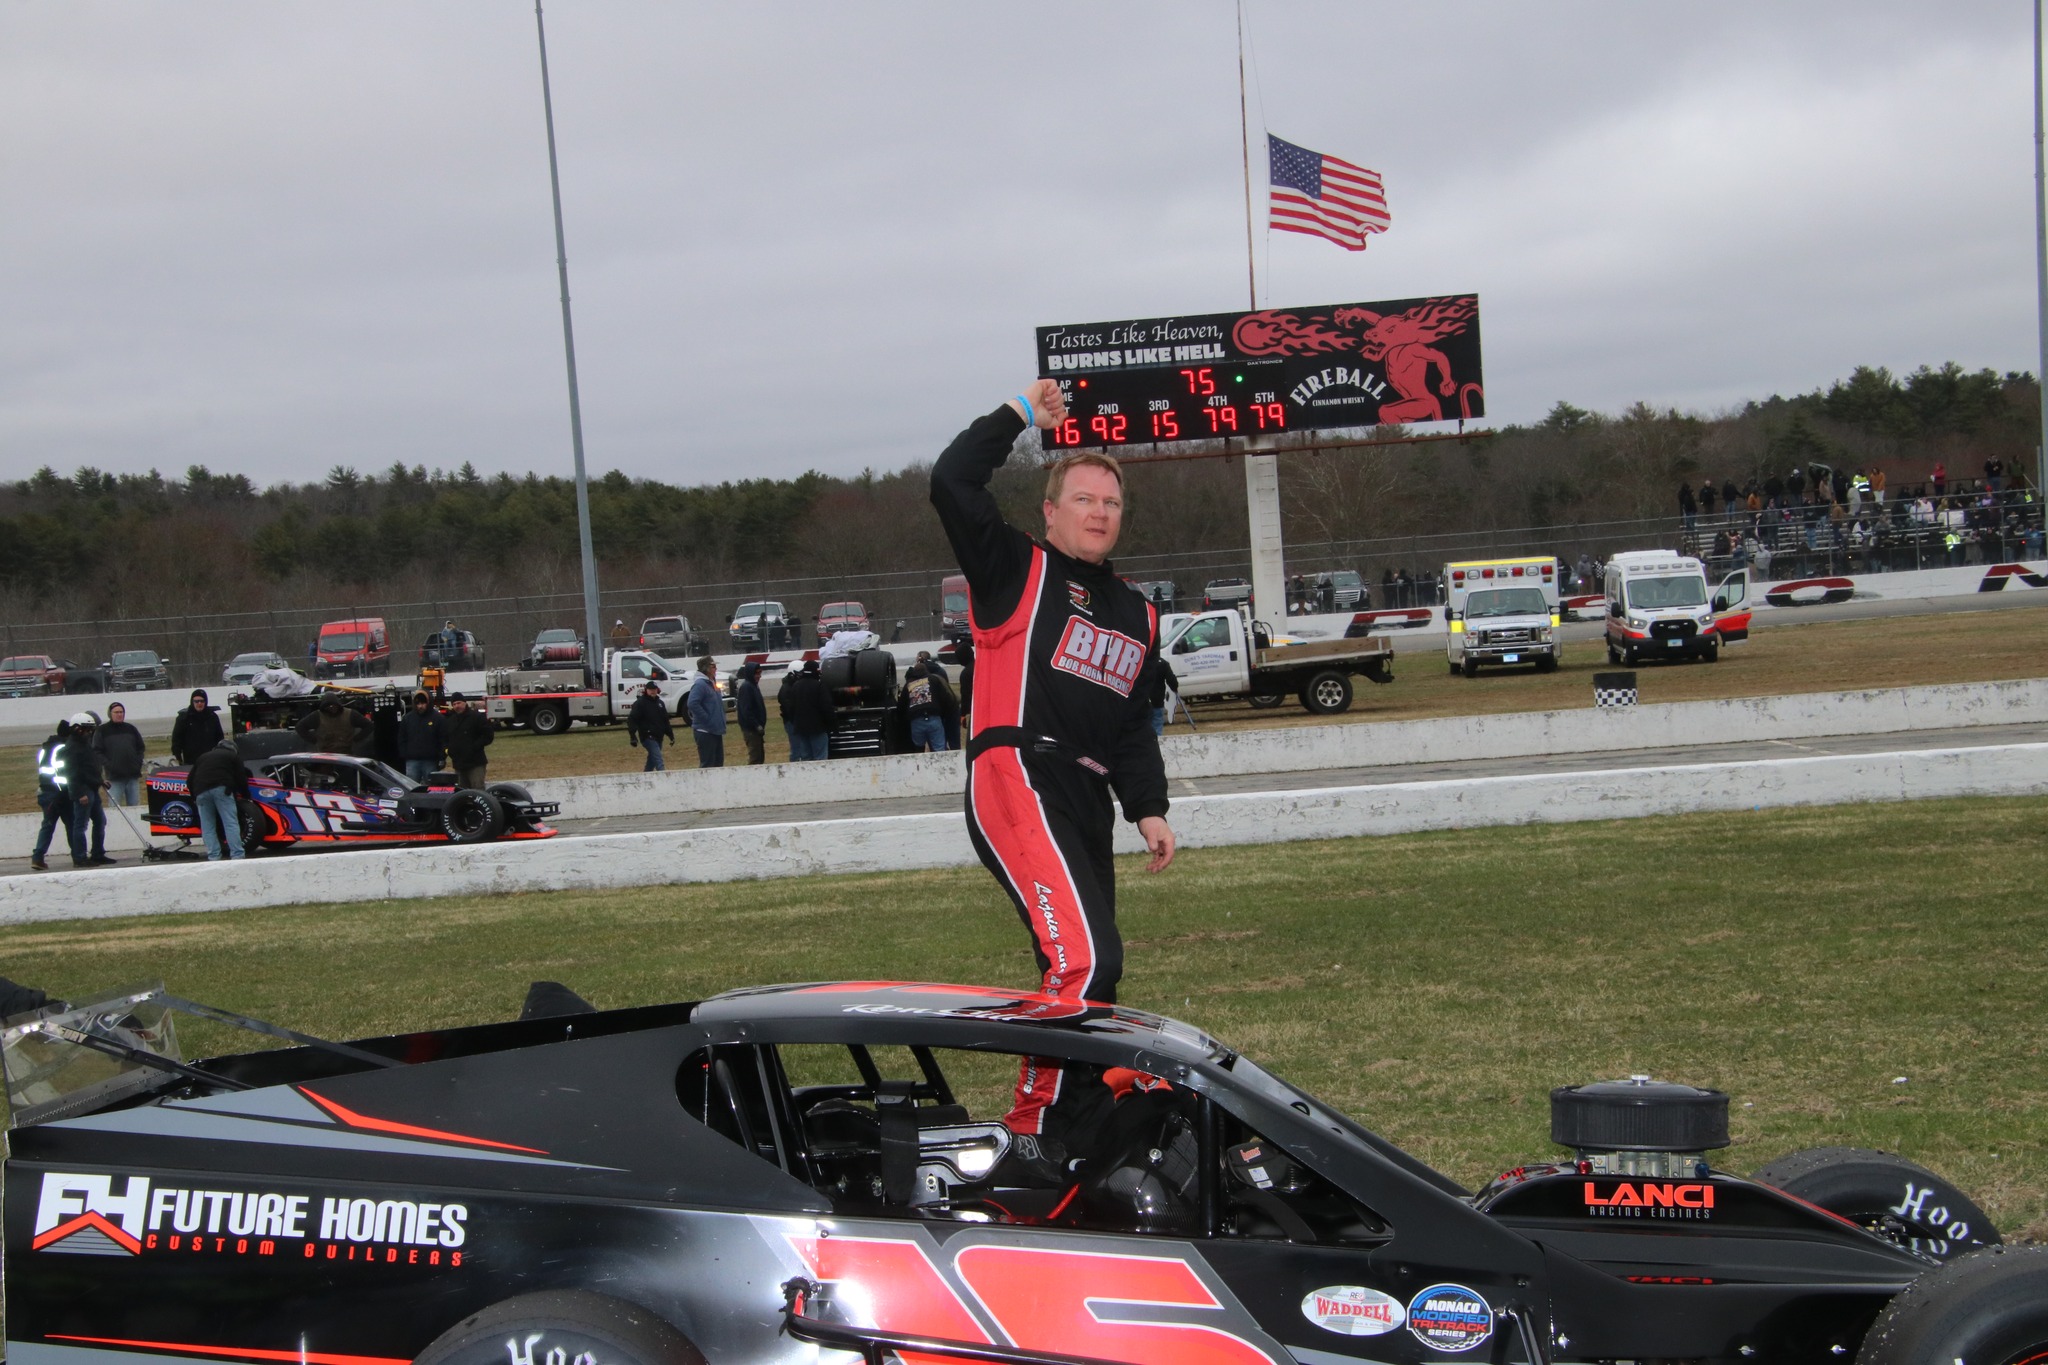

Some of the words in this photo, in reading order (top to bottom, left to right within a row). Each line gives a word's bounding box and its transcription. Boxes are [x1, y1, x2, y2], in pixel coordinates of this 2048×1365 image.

[1046, 328, 1102, 349] Tastes
[1108, 322, 1146, 346] Like
[1152, 319, 1223, 342] Heaven,
[1048, 350, 1123, 371] BURNS
[1124, 347, 1171, 365] LIKE
[1174, 343, 1226, 362] HELL
[1060, 380, 1072, 390] AP
[1180, 368, 1216, 395] 75
[1290, 367, 1387, 406] FIREBALL
[1097, 404, 1119, 415] 2ND
[1149, 399, 1170, 411] 3RD
[1207, 395, 1228, 406] 4TH
[1254, 391, 1275, 403] 5TH
[1312, 398, 1341, 406] CINNAMON
[1055, 418, 1080, 445] 16
[1091, 415, 1127, 442] 92
[1152, 411, 1179, 438] 15
[1203, 407, 1237, 432] 79
[1250, 403, 1284, 429] 79
[1058, 655, 1080, 672] BOB
[1064, 621, 1142, 681] BHR
[1584, 1181, 1715, 1209] LANCI
[148, 1188, 309, 1238] FUTURE
[320, 1197, 468, 1248] HOMES
[1589, 1205, 1641, 1218] RACING
[1650, 1207, 1711, 1220] ENGINES
[1889, 1182, 1984, 1245] Hoo
[146, 1233, 275, 1256] CUSTOM
[303, 1243, 463, 1267] BUILDERS
[1316, 1296, 1392, 1324] WADDELL
[1411, 1310, 1489, 1325] MODIFIED
[1424, 1299, 1481, 1314] MONACO
[1411, 1319, 1487, 1333] TRI-TRACK
[1427, 1329, 1466, 1338] SERIES
